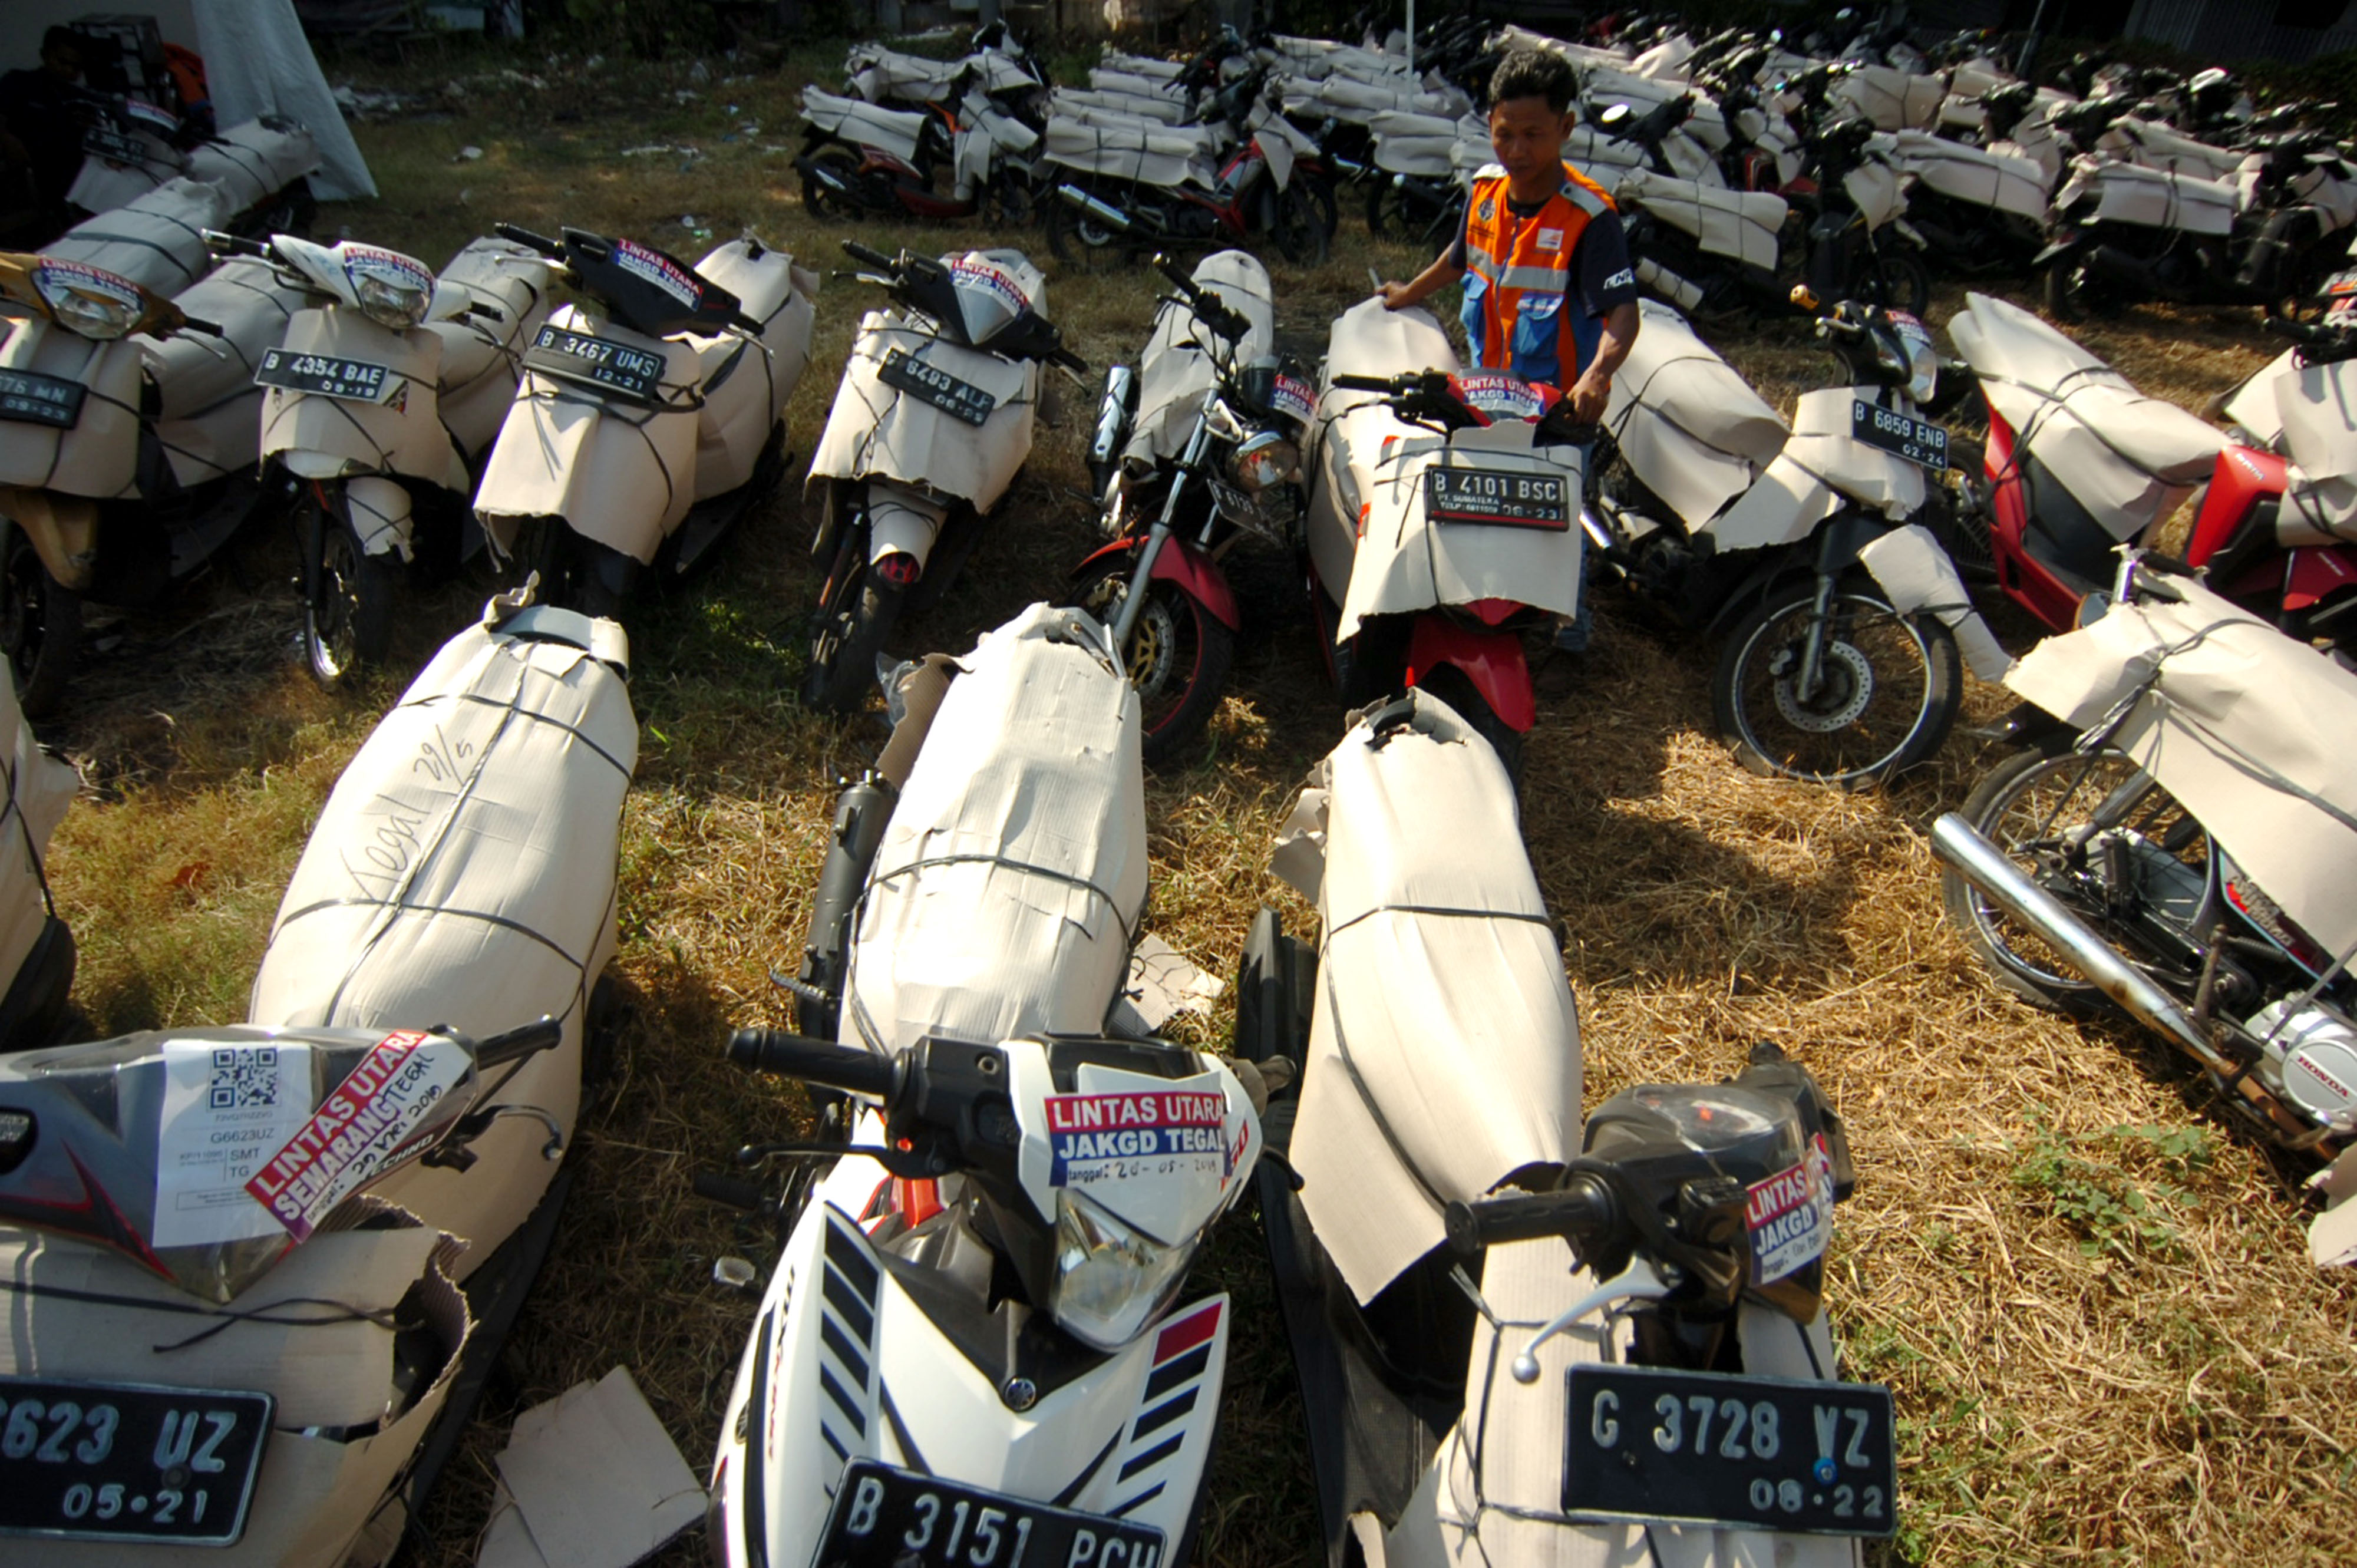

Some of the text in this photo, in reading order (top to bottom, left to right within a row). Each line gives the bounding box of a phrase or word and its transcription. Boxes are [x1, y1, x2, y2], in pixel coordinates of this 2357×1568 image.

[42, 258, 140, 292] LINTAS UTARA
[618, 252, 696, 301] JAKGD TEGAL
[620, 237, 699, 295] LINTAS UTARA
[954, 259, 1025, 304] LINTAS UTARA
[265, 352, 383, 385] B 4354 BAE
[541, 331, 655, 377] B 3467 UMS
[1276, 378, 1310, 401] LINTAS
[1460, 377, 1506, 391] LINTAS
[1856, 402, 1945, 448] B 6859 ENB
[1434, 473, 1557, 501] B 4101 BSC
[339, 793, 431, 902] Tegal
[2297, 1055, 2349, 1098] HONDA
[256, 1030, 423, 1197] LINTAS UTARA
[1054, 1095, 1223, 1128] LINTAS UTARA
[210, 1128, 275, 1144] G6623UZ
[230, 1148, 261, 1161] SMT
[273, 1052, 435, 1221] SEMARANG TEGAL
[1059, 1128, 1226, 1160] JAKGD TEGAL
[230, 1165, 250, 1178] TG
[1747, 1169, 1807, 1223] LINTAS
[1755, 1203, 1814, 1256] JAKGD
[0, 1395, 238, 1473] 623 UZ
[1591, 1388, 1620, 1450] G
[1652, 1392, 1781, 1461] 3728
[846, 1475, 885, 1535] B
[904, 1491, 1034, 1568] 3151
